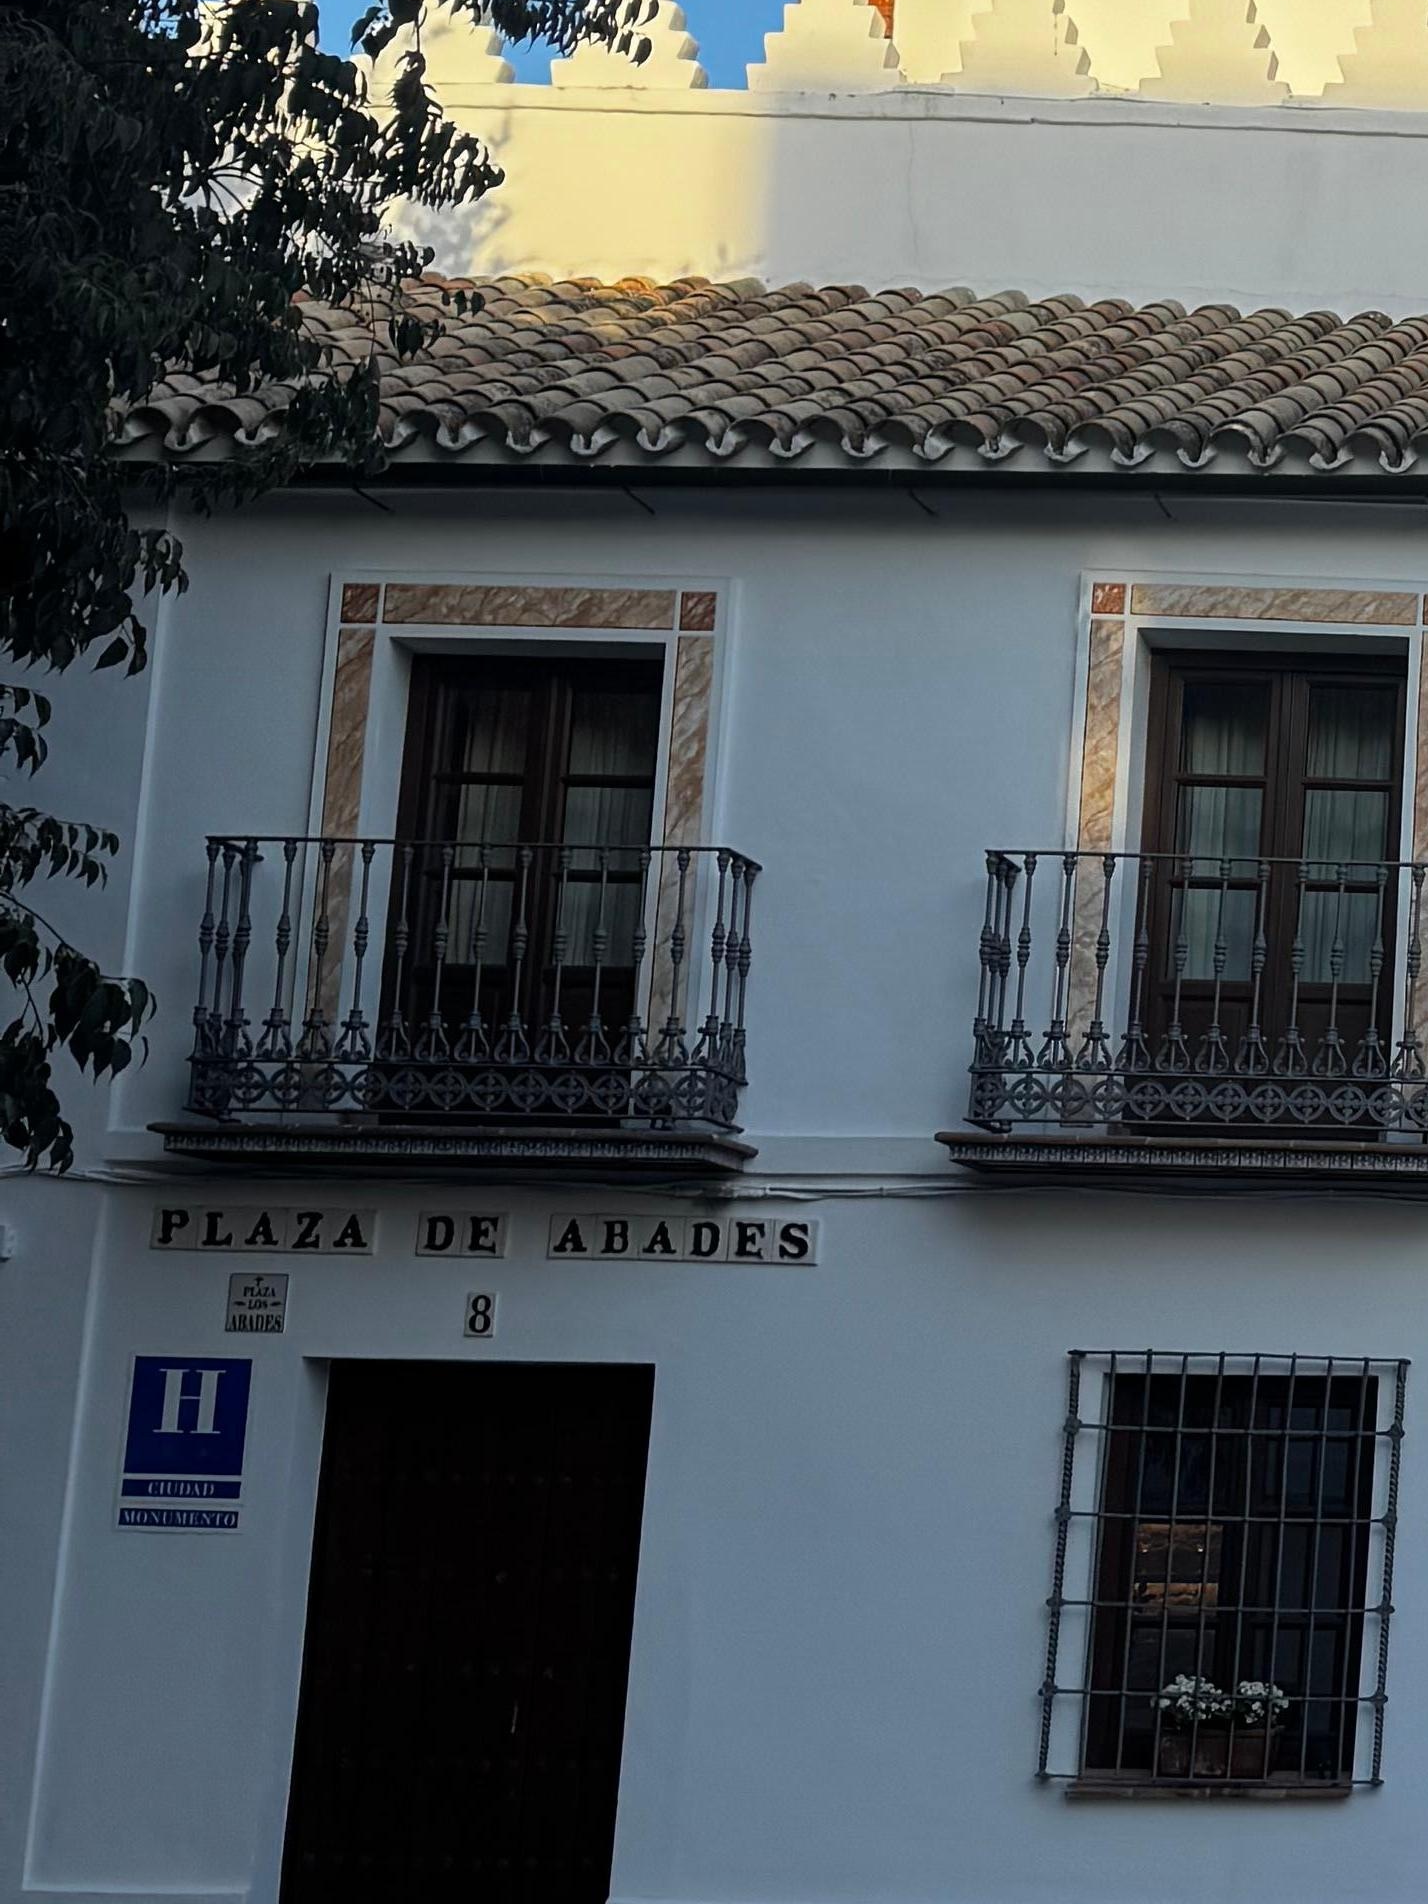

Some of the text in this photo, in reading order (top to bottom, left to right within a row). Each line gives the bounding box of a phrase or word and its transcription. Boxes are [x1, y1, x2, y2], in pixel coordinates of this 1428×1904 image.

[157, 1208, 810, 1259] PLAZA DE ABADES
[468, 1294, 491, 1333] 8
[152, 1368, 227, 1434] H
[147, 1482, 215, 1496] CIUDAD
[123, 1510, 236, 1526] MONUMENTO
